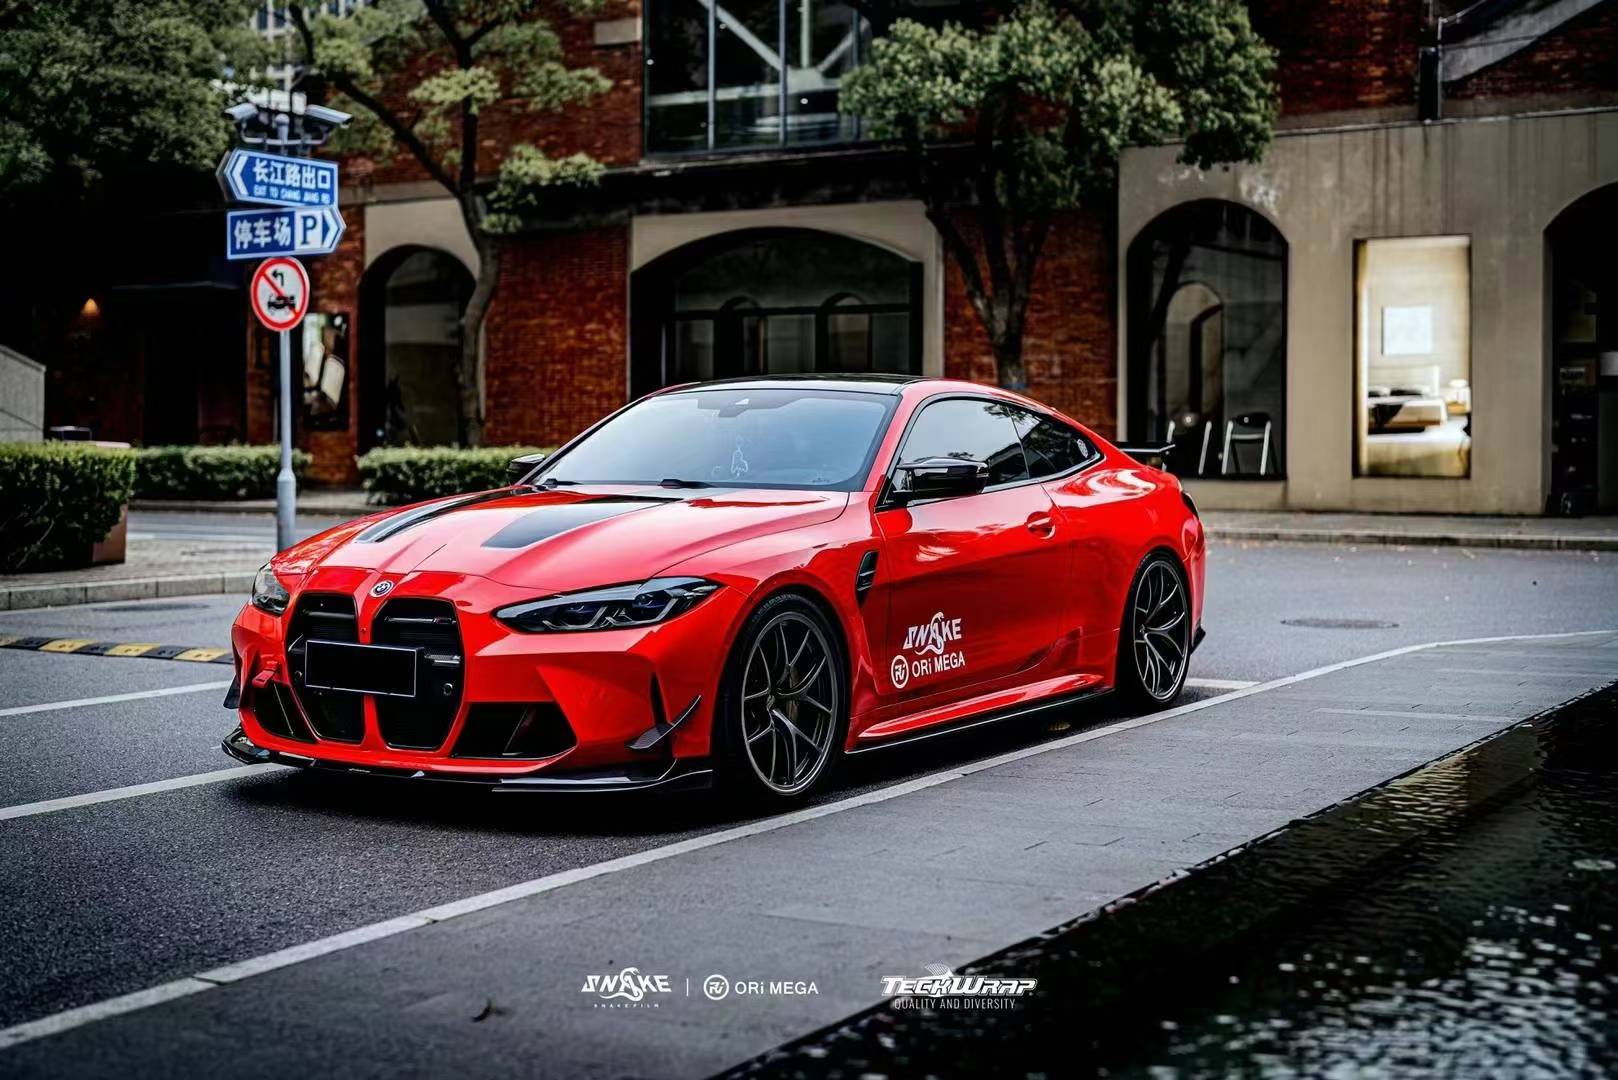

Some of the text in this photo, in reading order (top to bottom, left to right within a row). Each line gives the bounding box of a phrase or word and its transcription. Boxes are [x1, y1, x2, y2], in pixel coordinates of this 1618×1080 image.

[253, 158, 331, 190] 长江路出口
[234, 215, 318, 250] 停车场 P
[902, 613, 962, 653] SNAKE
[934, 650, 966, 673] MEGA
